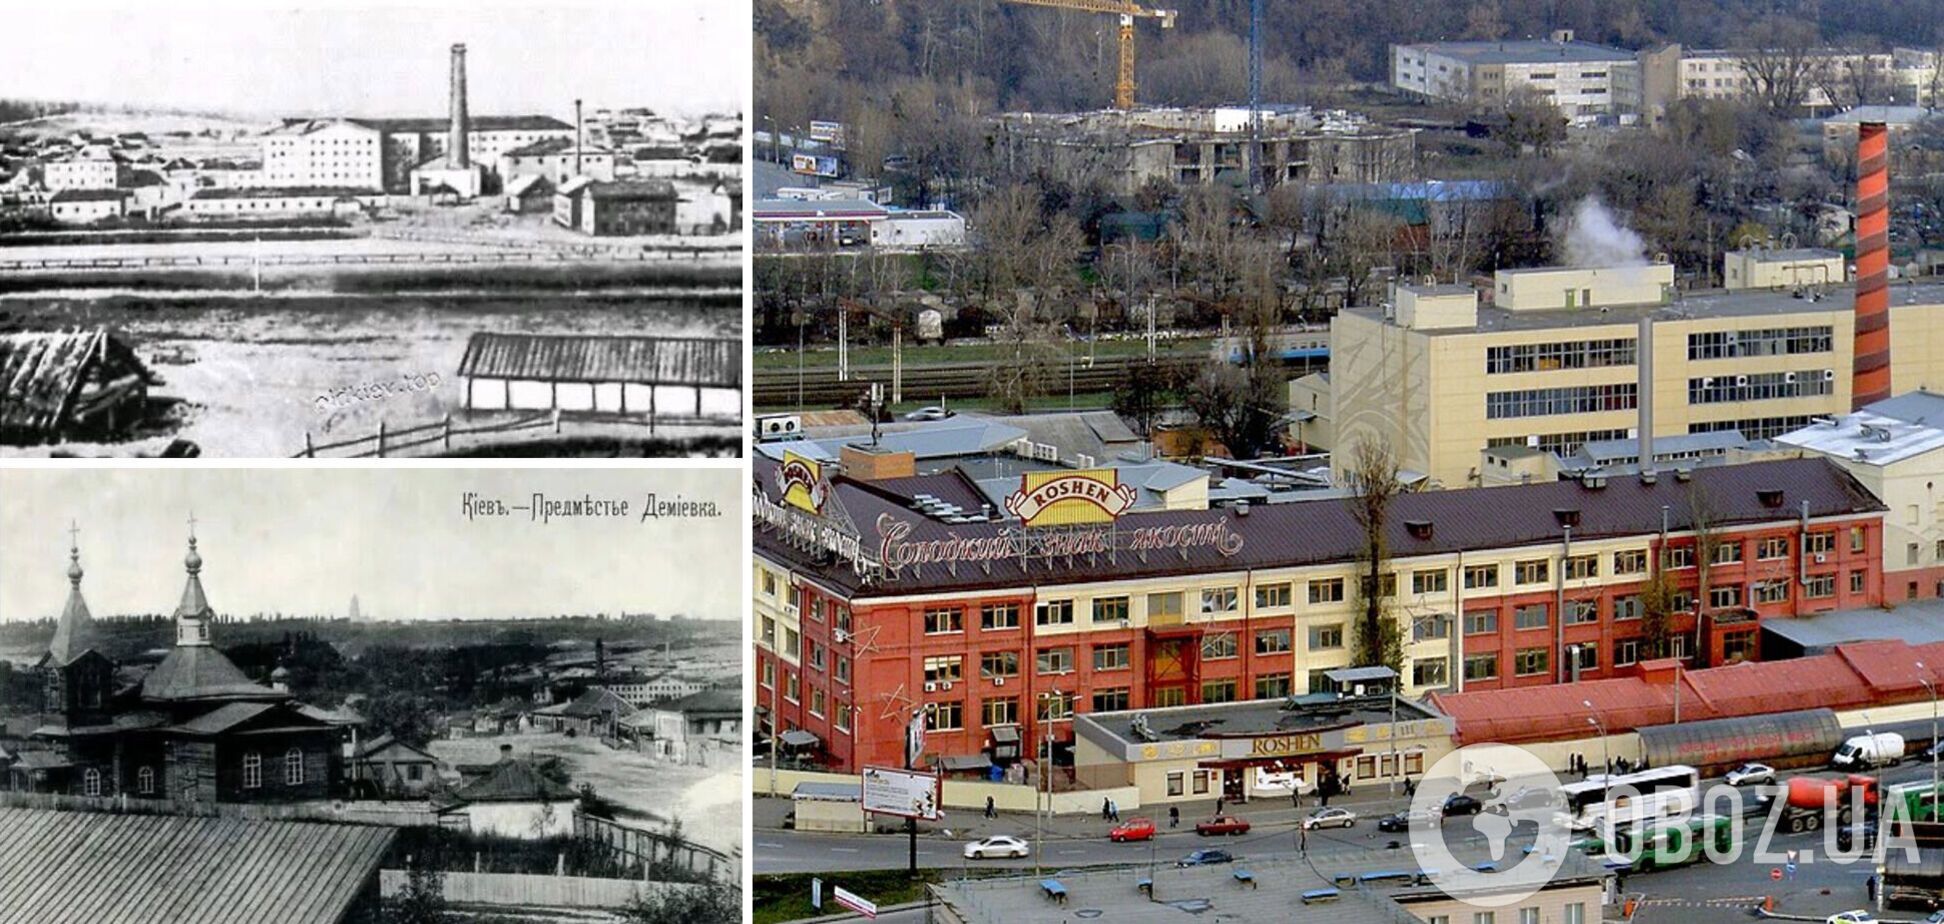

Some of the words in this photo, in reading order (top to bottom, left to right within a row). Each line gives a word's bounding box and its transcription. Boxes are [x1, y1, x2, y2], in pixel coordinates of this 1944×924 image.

[1032, 480, 1111, 507] ROSHEN
[1040, 530, 1104, 557] знак
[1130, 515, 1244, 557] якості
[1251, 733, 1321, 755] ROSHEN
